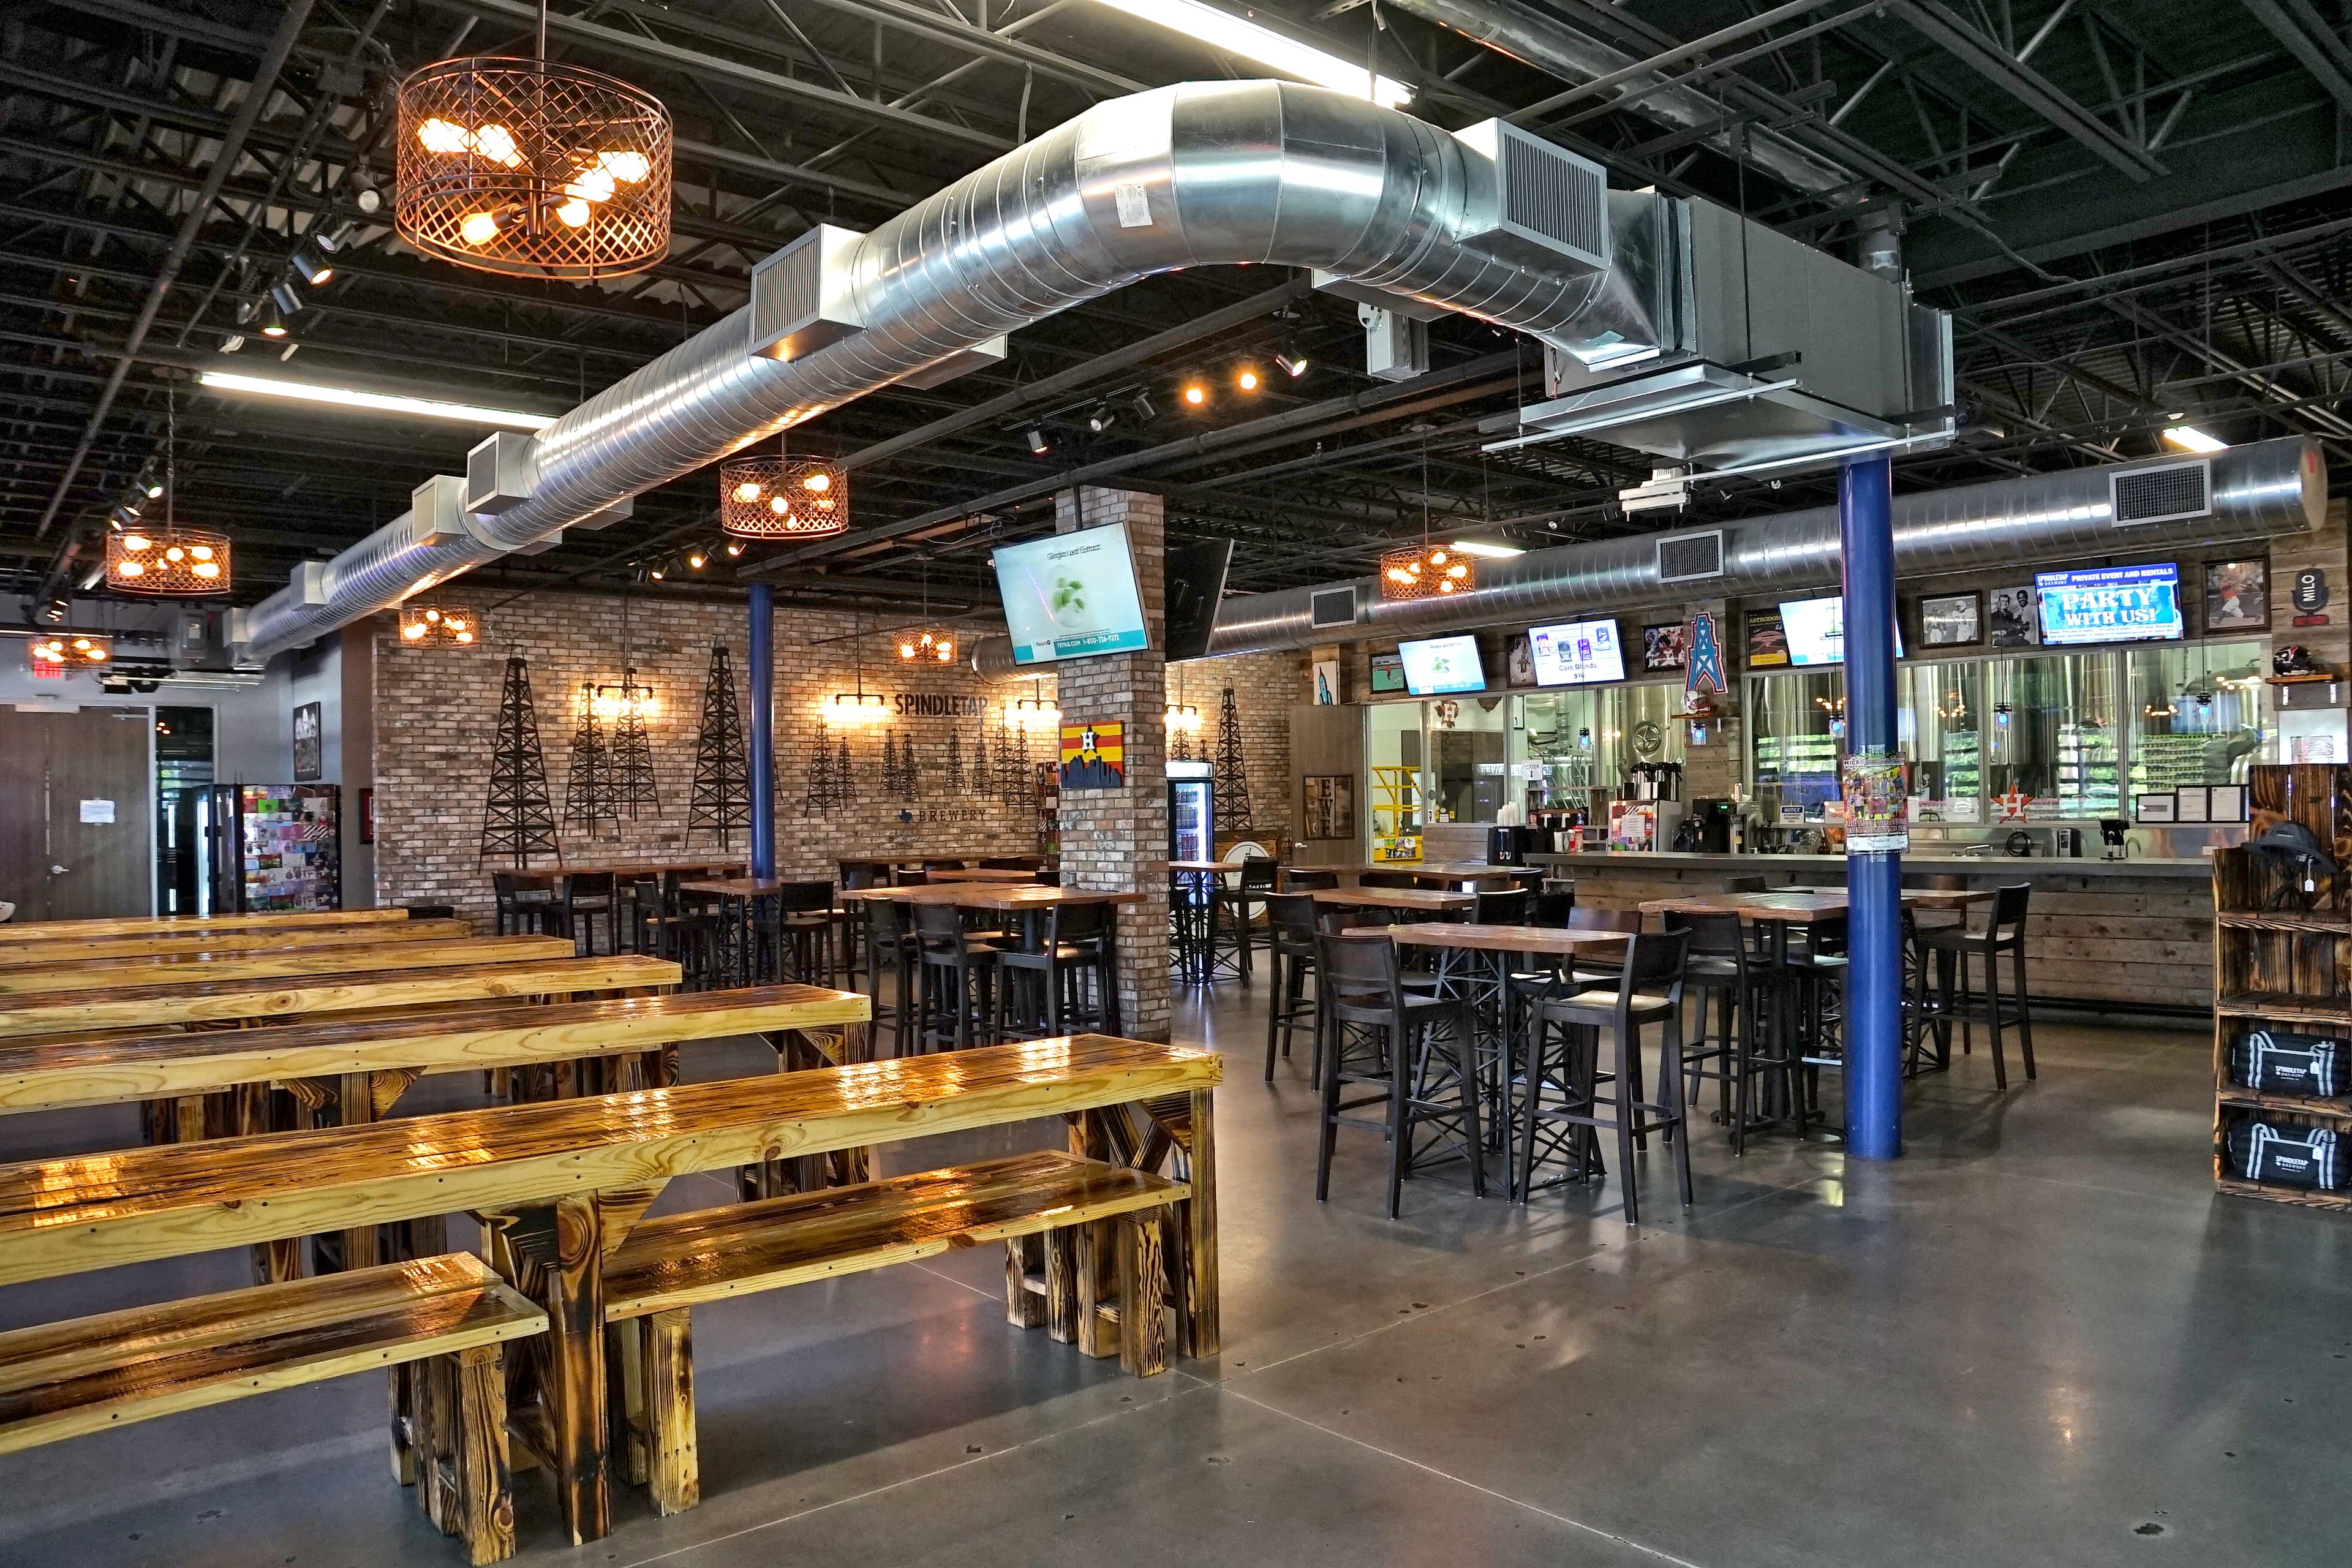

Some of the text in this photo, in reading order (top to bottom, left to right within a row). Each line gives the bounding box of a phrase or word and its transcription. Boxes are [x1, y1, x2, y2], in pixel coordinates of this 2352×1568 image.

[2141, 568, 2174, 577] RENTALS
[2301, 575, 2316, 602] MILO
[2062, 587, 2153, 611] PARTY
[2064, 608, 2157, 626] WITH US!
[895, 693, 989, 716] SPINDLETAP
[1081, 731, 1095, 750] H
[2000, 794, 2024, 817] H
[919, 809, 987, 822] BREWERY
[2275, 1065, 2308, 1074] SPINDLETAP
[2275, 1155, 2309, 1166] SPINDLETAP
